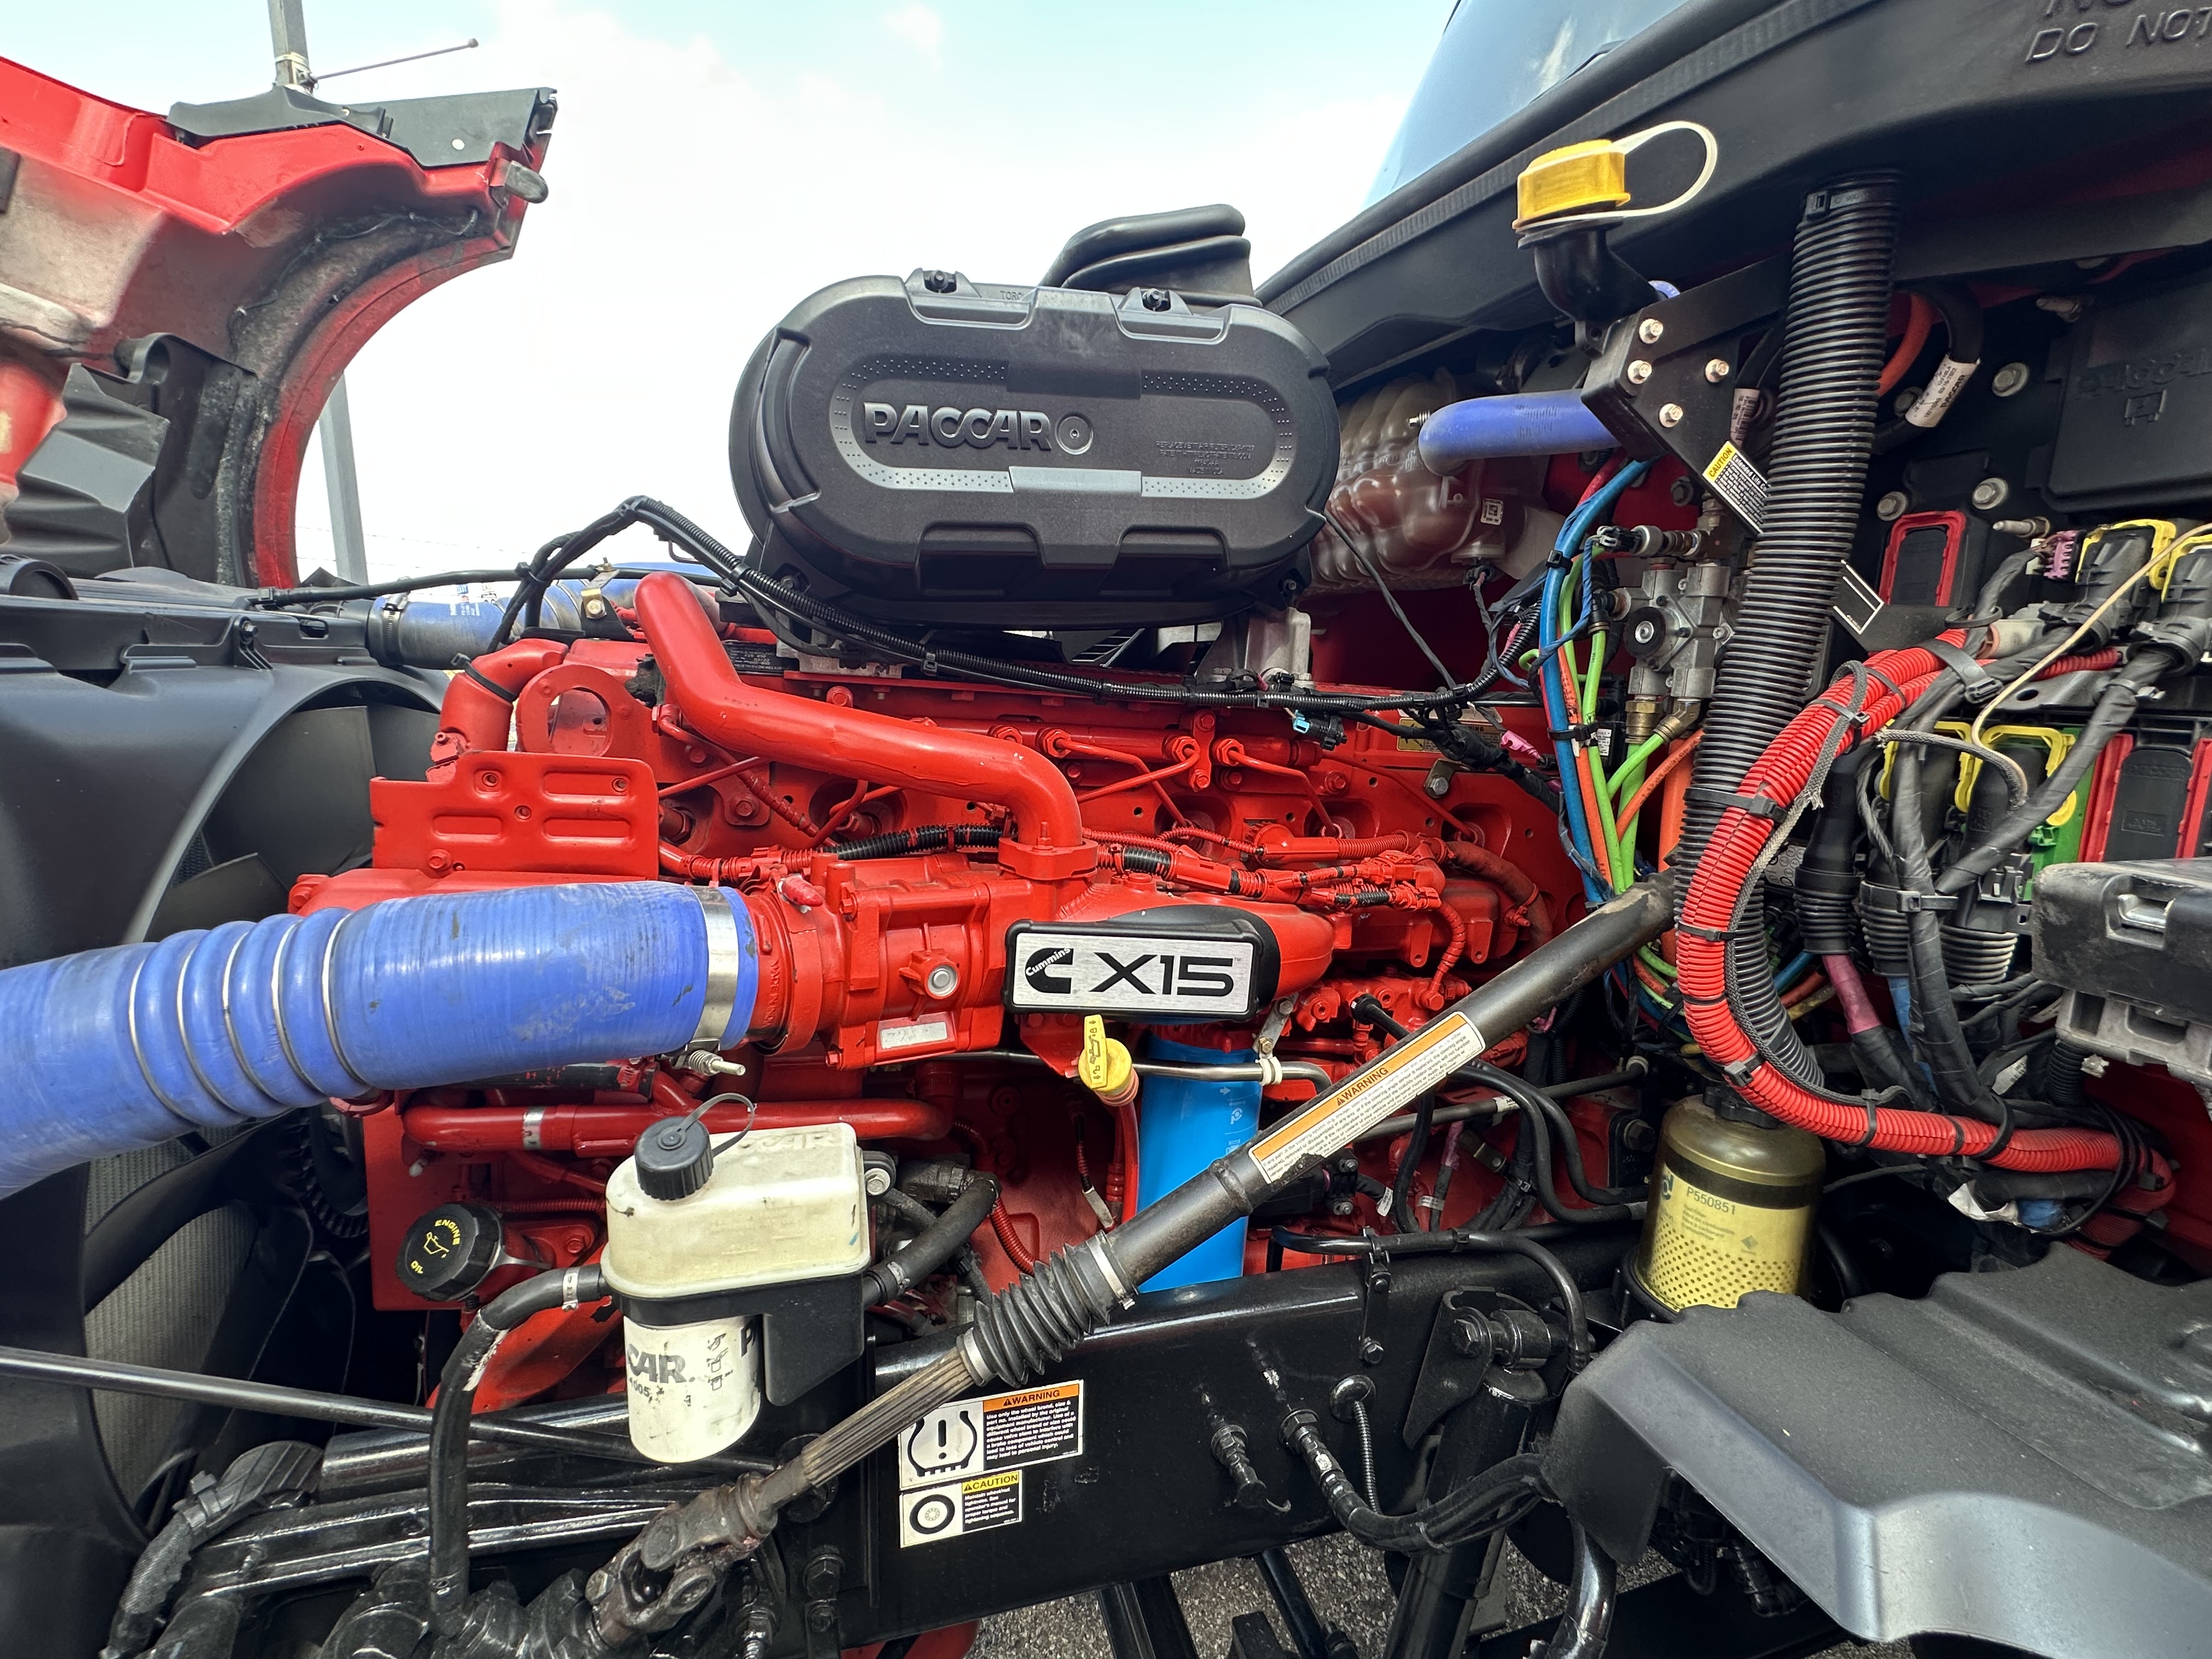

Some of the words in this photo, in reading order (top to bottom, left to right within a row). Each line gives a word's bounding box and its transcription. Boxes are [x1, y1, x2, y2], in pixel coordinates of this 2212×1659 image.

[2024, 22, 2098, 64] DO
[1940, 374, 1966, 408] PACCAR
[863, 403, 1052, 451] PACCAR
[1709, 447, 1733, 477] CAUTION
[1733, 455, 1752, 477] Extended
[1025, 946, 1071, 977] Cummins
[1089, 952, 1234, 997] X15
[1427, 1059, 1441, 1071] system
[1454, 1039, 1471, 1052] function
[1342, 1066, 1389, 1101] WARNING
[1284, 1146, 1302, 1160] removed
[1370, 1088, 1387, 1103] steering
[1386, 1081, 1398, 1091] angle
[1439, 1042, 1456, 1056] steering
[1454, 1035, 1466, 1045] angle
[1686, 1186, 1736, 1215] P550851
[435, 1219, 461, 1246] ENGINE
[410, 1260, 424, 1274] OIL
[1012, 1390, 1060, 1404] WARNING
[1007, 1413, 1032, 1422] installed
[1048, 1406, 1069, 1414] original
[1020, 1406, 1037, 1414] wheel
[986, 1421, 1015, 1432] equipment
[986, 1428, 1009, 1438] different
[1009, 1425, 1026, 1433] wheel
[1039, 1425, 1062, 1433] interfere
[1006, 1435, 1037, 1444] component
[1017, 1446, 1042, 1455] personal
[973, 1474, 1018, 1489] CAUTION
